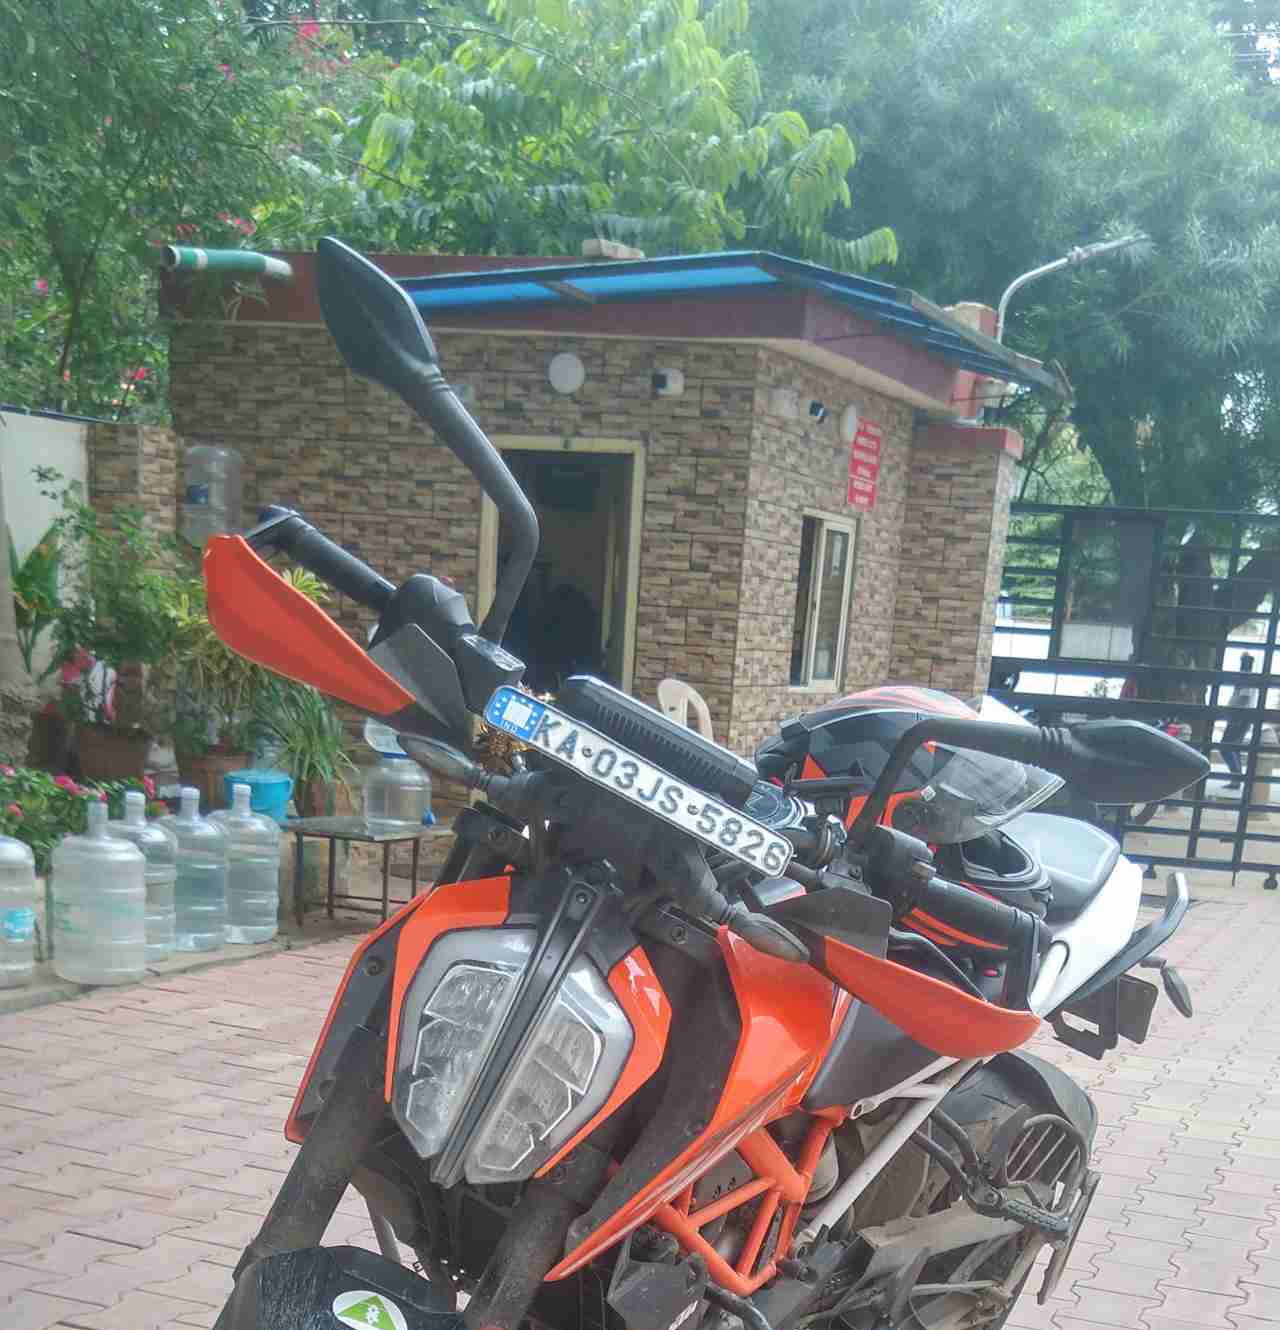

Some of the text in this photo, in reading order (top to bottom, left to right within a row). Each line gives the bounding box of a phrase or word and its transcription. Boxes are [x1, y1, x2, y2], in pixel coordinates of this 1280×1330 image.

[533, 712, 787, 871] KA 03JS 5826
